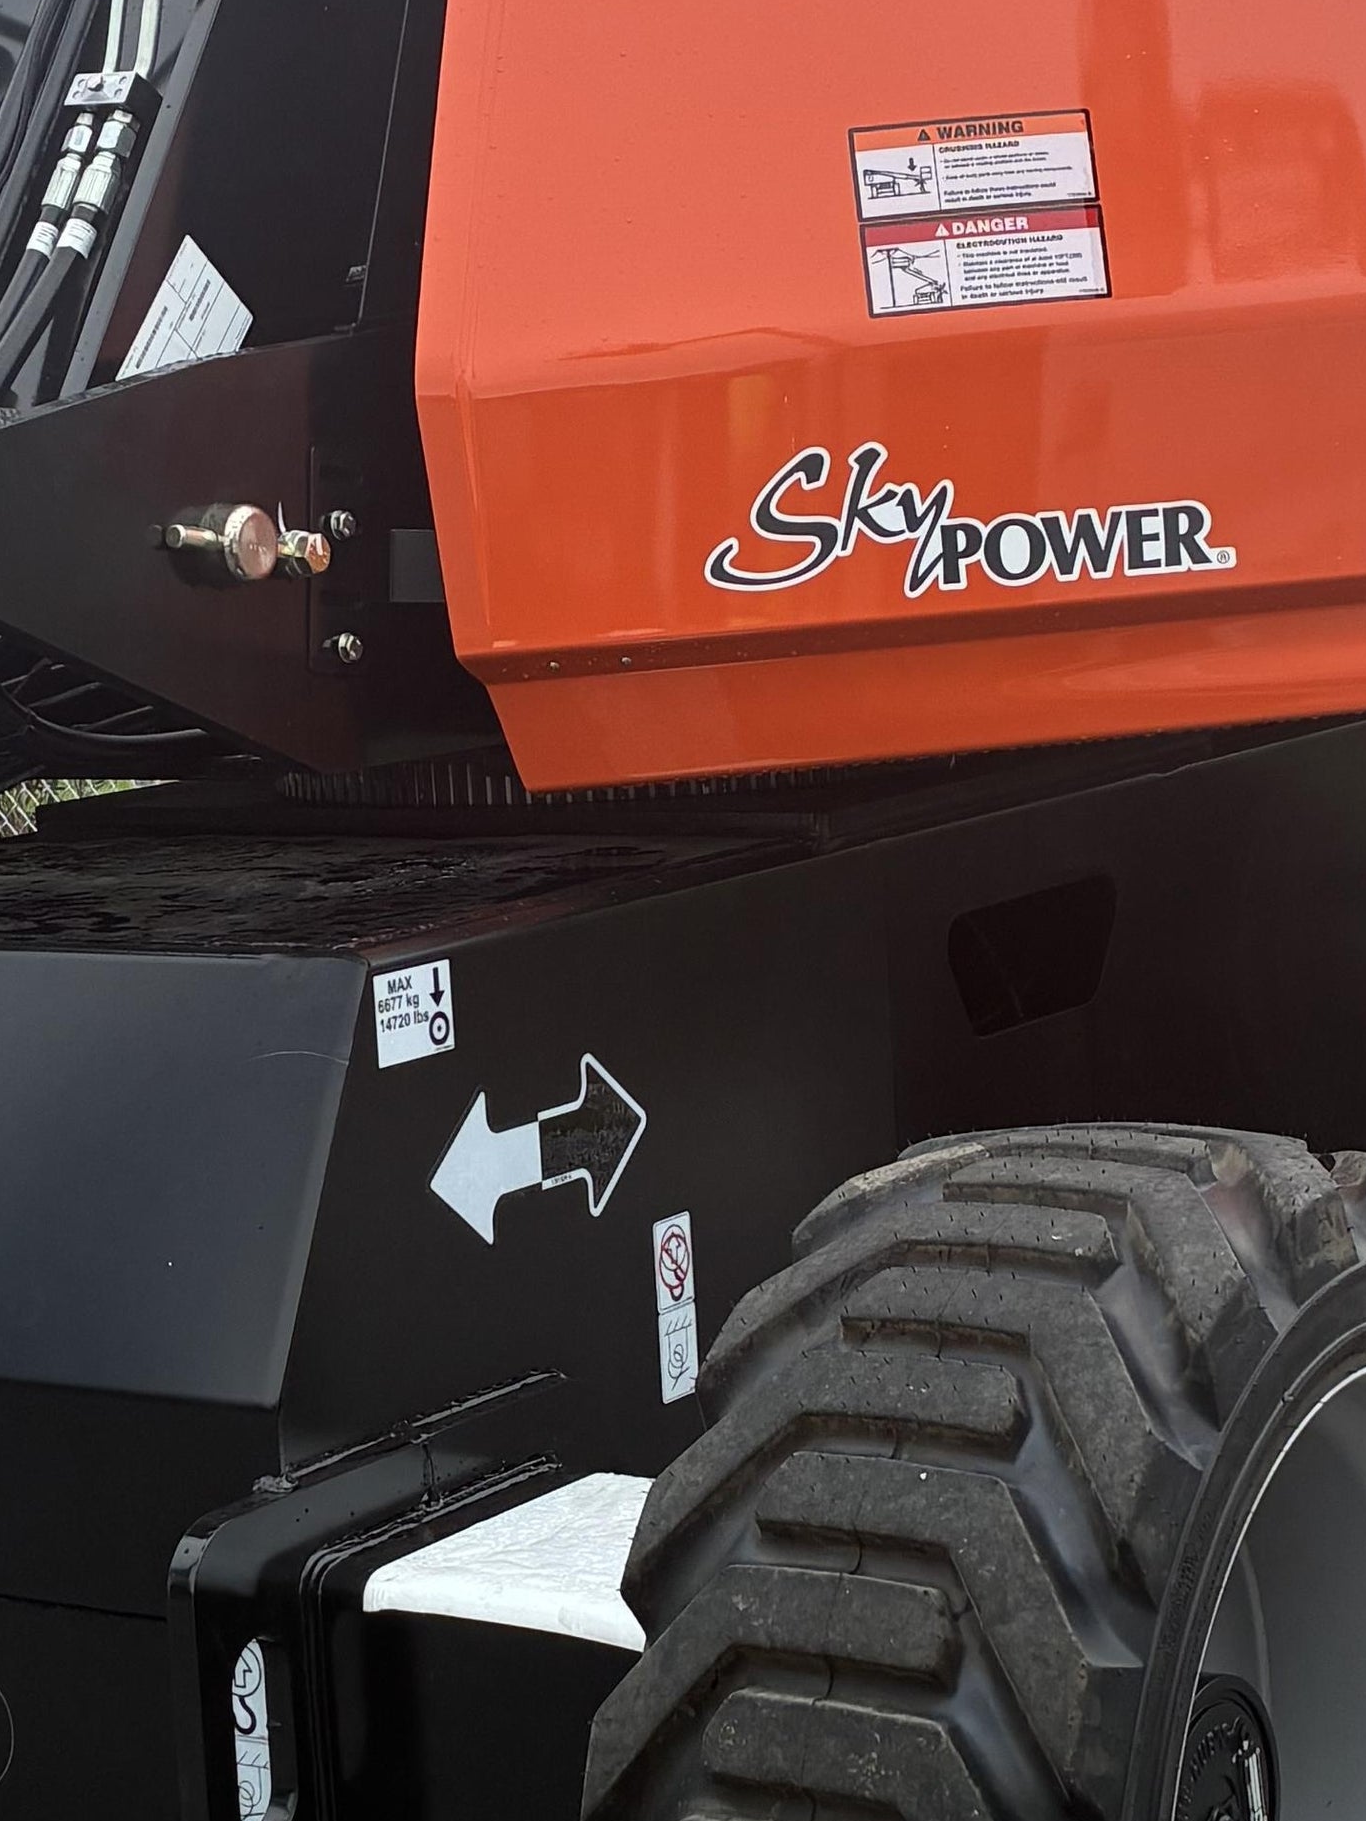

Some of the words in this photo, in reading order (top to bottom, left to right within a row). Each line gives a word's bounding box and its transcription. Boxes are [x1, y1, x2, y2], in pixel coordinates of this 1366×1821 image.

[936, 120, 1024, 140] WARNING
[952, 216, 1029, 236] DANGER
[387, 975, 413, 995] MAX
[378, 995, 403, 1014] 6677
[406, 993, 420, 1009] kg
[380, 1013, 411, 1033] 14720
[413, 1010, 430, 1025] lbs
